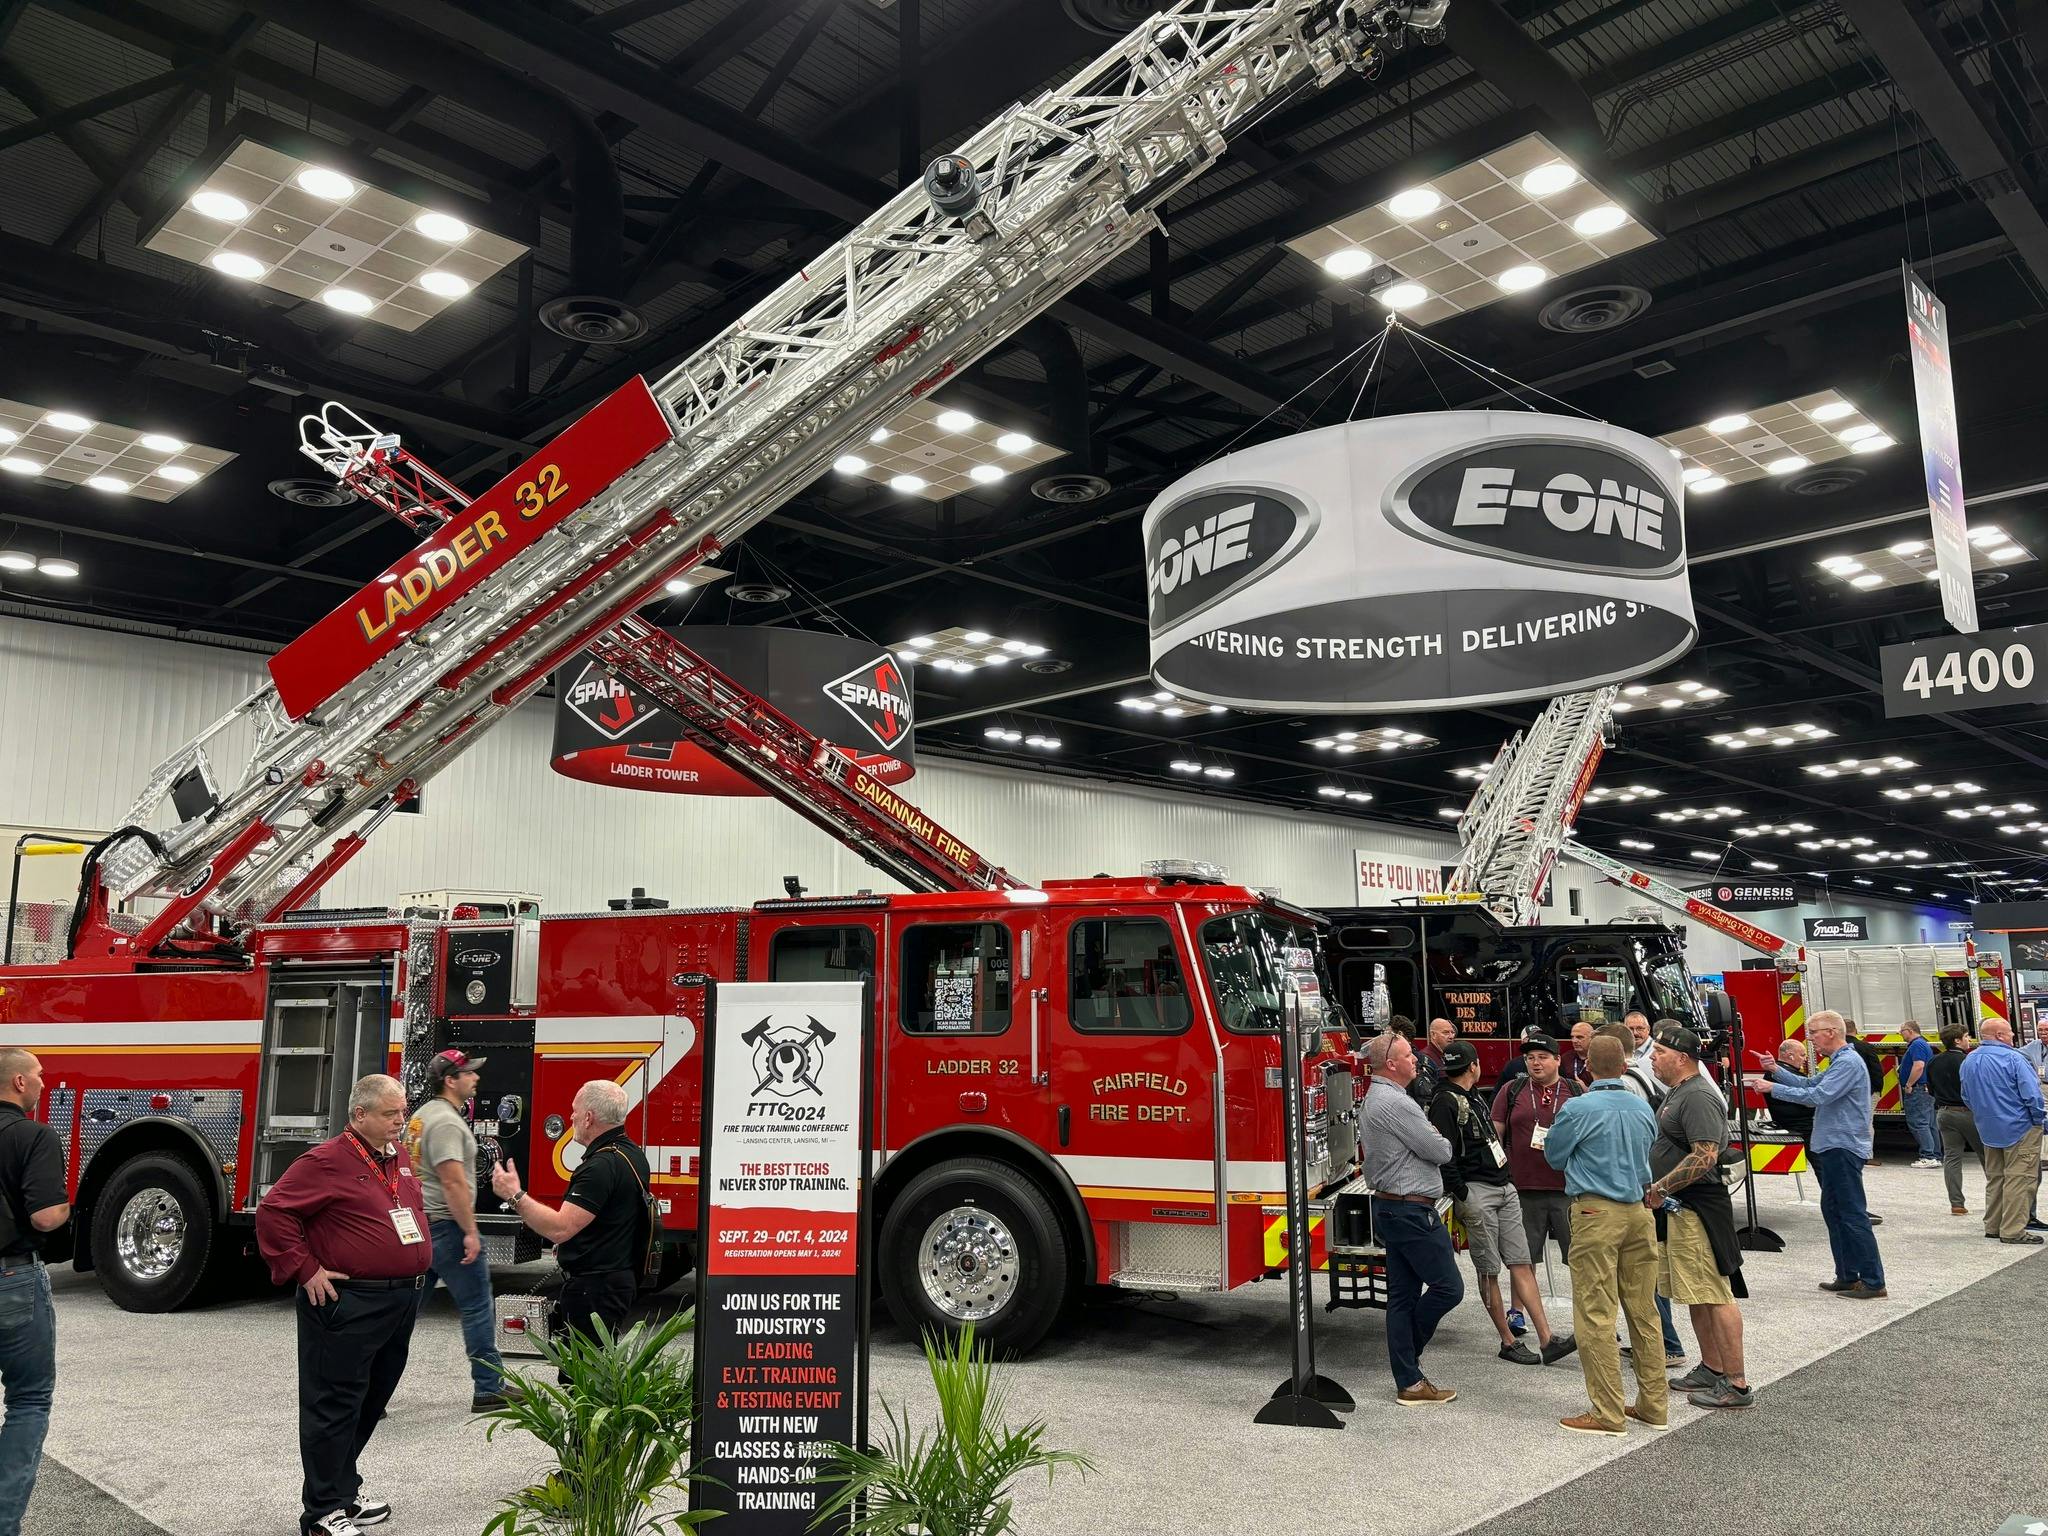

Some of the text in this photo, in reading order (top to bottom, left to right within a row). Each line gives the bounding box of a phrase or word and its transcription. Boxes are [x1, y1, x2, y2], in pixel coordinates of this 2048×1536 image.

[1452, 467, 1664, 551] E-ONE
[357, 464, 569, 642] LADDER 32
[1946, 573, 1971, 625] 4400
[1462, 601, 1616, 652] DELIVERING
[1296, 633, 1442, 660] STRENGTH
[1902, 643, 2035, 700] 4400
[841, 682, 911, 722] SPARTAN
[610, 762, 699, 783] LADDER TOWER
[878, 760, 902, 774] TOWER
[854, 774, 972, 867] SAVANNAH FIRE
[185, 869, 209, 894] E-ONE
[1360, 861, 1441, 894] SEE YOU NEX
[1733, 887, 1794, 897] GENESIS
[1698, 904, 1772, 944] WASHINGTON D.C.
[461, 954, 492, 963] E-ONE
[677, 975, 705, 984] E-ONE
[1445, 992, 1492, 1005] "RAPIDES
[1455, 1006, 1476, 1019] DES
[1461, 1021, 1498, 1033] PERES"
[927, 1059, 1019, 1074] LADDER 32
[1092, 1072, 1188, 1096] FAIRFIELD
[1090, 1104, 1190, 1122] FIRE DEPT.
[1290, 1077, 1298, 1152] LADDER
[723, 1125, 740, 1133] FIRE
[766, 1124, 800, 1132] TRAINING
[801, 1124, 849, 1132] CONFERENCE
[740, 1162, 830, 1176] THE BEST TECHS
[719, 1177, 849, 1191] NEVER STOP TRAINING.
[1154, 1210, 1209, 1218] TYPHOON
[718, 1230, 749, 1243] SEPT.
[804, 1230, 815, 1245] 4,
[818, 1230, 848, 1243] 2024
[813, 1250, 820, 1258] 1,
[721, 1293, 841, 1310] JOIN US FOR THE
[1297, 1260, 1305, 1332] METRO
[735, 1317, 826, 1335] INDUSTRY'S
[747, 1342, 813, 1359] LEADING
[722, 1367, 836, 1384] E.V.T. TRAINING
[717, 1391, 842, 1409] & TESTING EVENT
[739, 1416, 818, 1433] WITH NEW
[714, 1441, 780, 1459] CLASSES
[783, 1441, 795, 1459] &
[738, 1466, 816, 1484] HANDS-ON
[736, 1492, 816, 1510] TRAINING!
